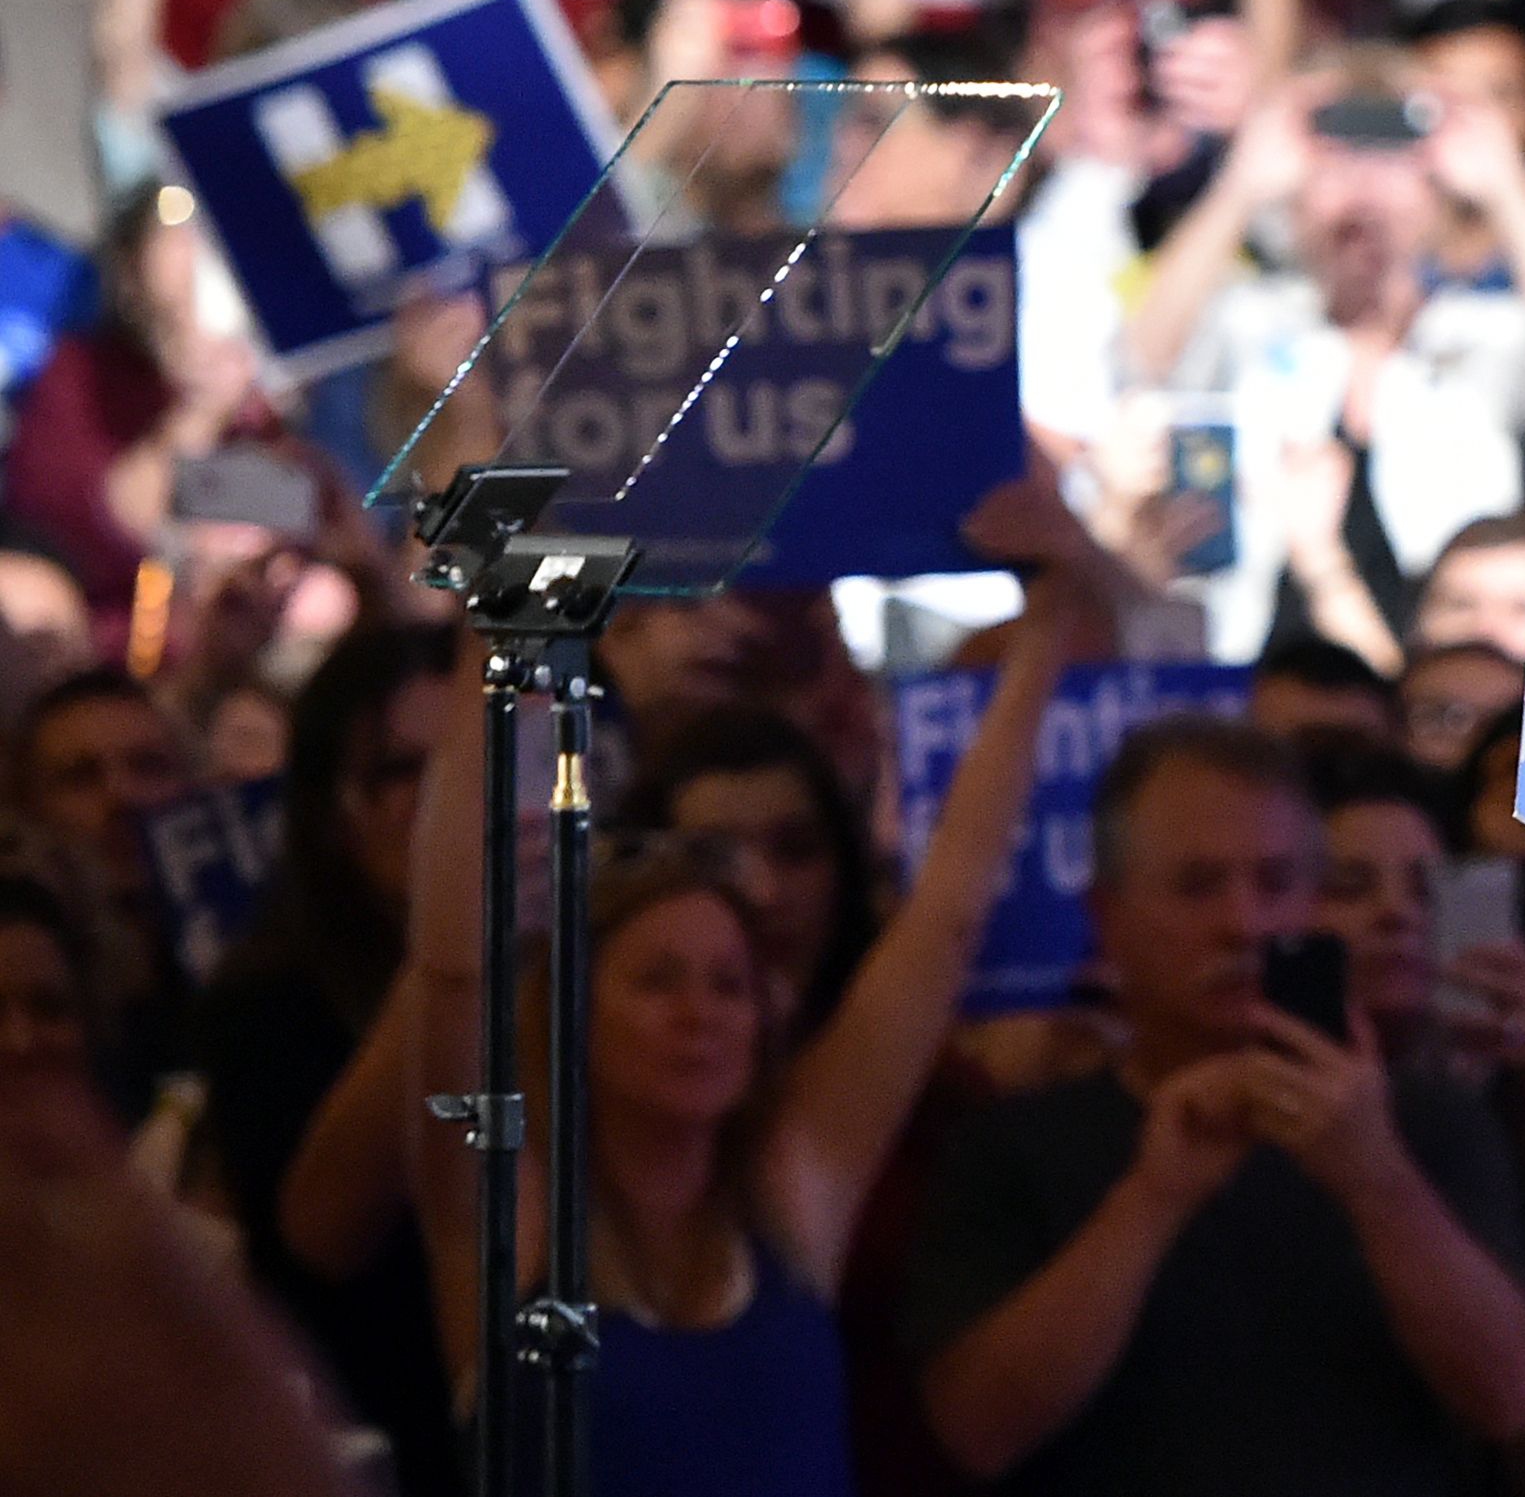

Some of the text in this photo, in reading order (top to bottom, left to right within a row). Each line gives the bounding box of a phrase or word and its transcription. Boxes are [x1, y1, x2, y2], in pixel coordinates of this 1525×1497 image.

[490, 241, 1016, 381] Fighting
[504, 366, 857, 472] for us
